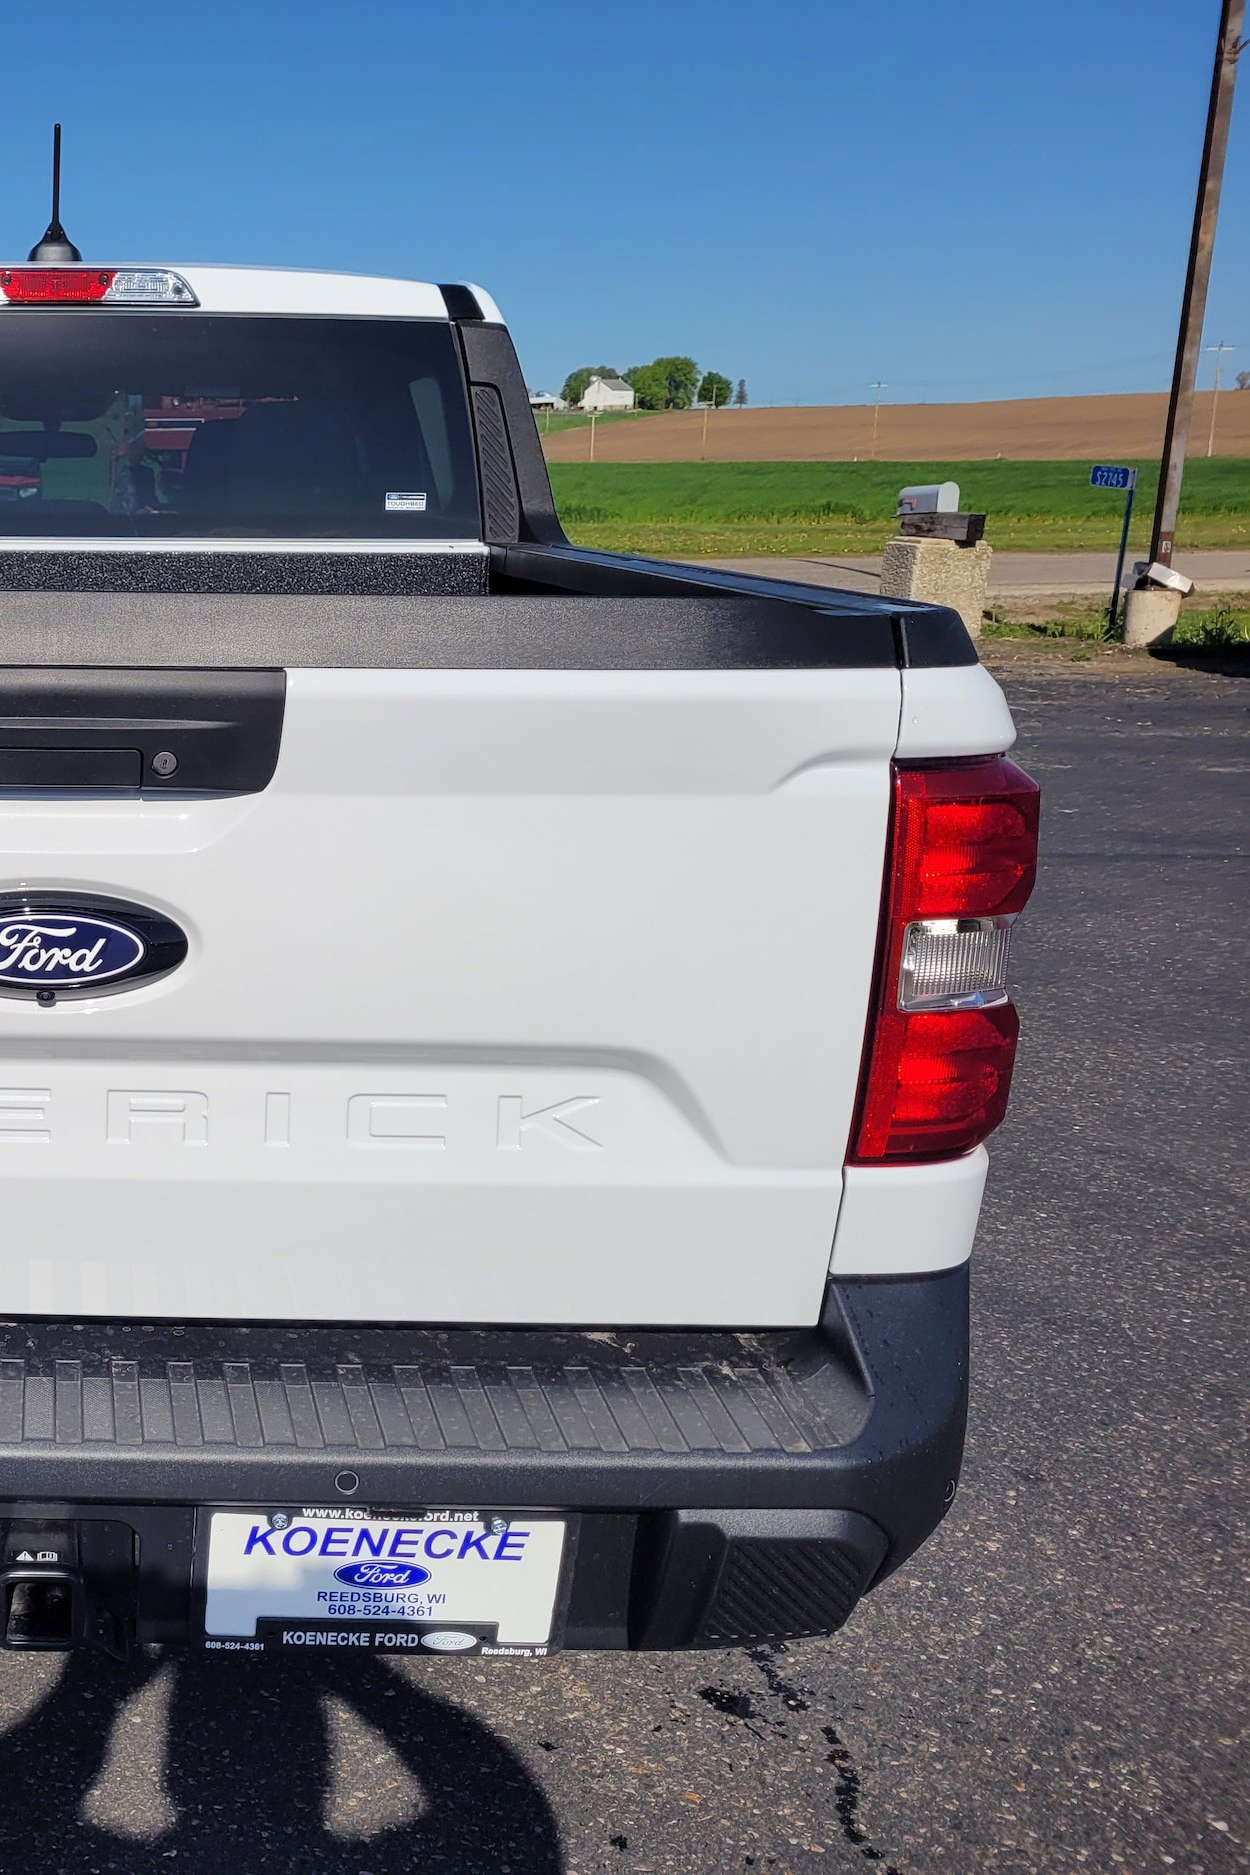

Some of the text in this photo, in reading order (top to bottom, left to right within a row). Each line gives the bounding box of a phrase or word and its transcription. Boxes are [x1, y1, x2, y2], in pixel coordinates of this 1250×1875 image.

[1095, 471, 1124, 488] S2745
[244, 1526, 530, 1561] KOENECKE
[353, 1563, 411, 1584] Ford
[317, 1591, 447, 1606] REEDSBURG, WI
[328, 1604, 434, 1617] 608-524-4361
[205, 1641, 265, 1651] 608-524-4361
[282, 1631, 465, 1648] KOENECKE FORD Ford
[481, 1647, 548, 1657] Reedsburg, WI
